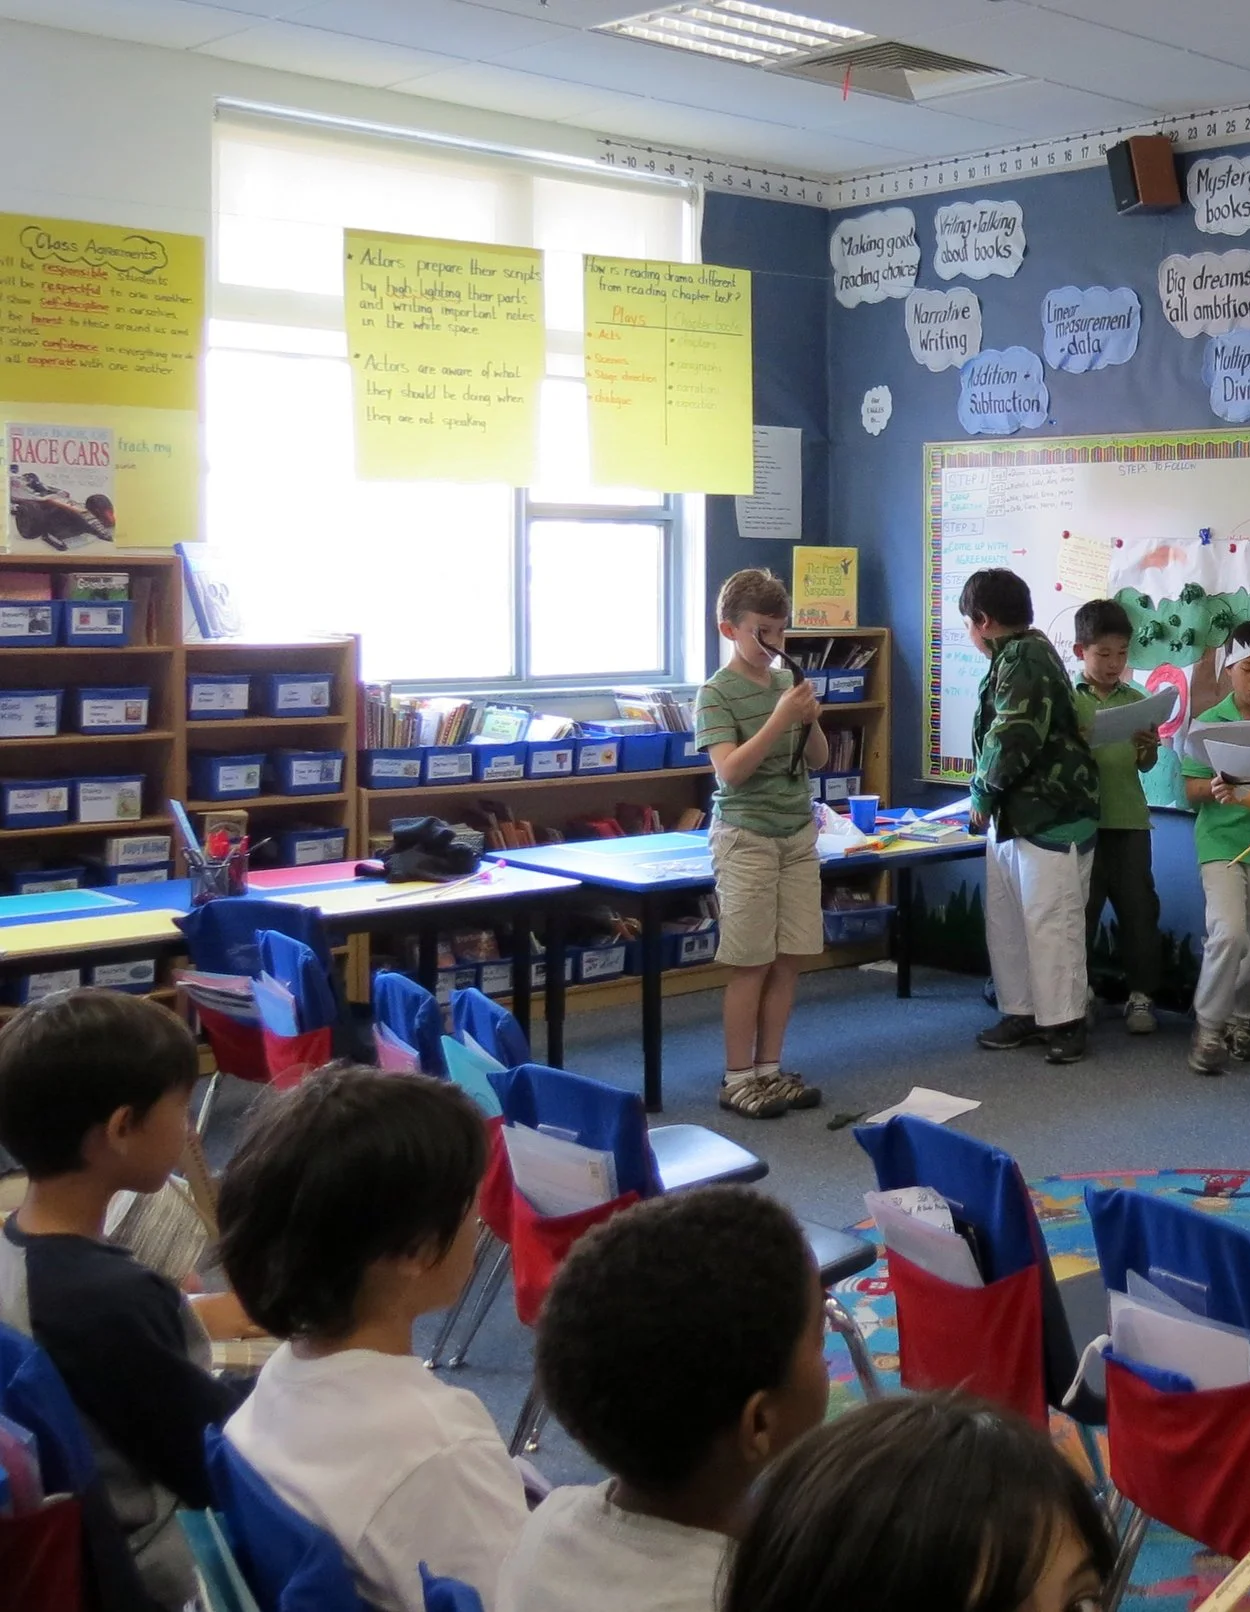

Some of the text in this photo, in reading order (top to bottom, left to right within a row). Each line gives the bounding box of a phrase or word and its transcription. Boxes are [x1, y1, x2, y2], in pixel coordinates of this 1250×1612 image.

[968, 156, 1038, 178] 10 14
[704, 171, 822, 202] -6 -2 0
[978, 211, 1017, 237] Talking
[35, 233, 78, 251] Class
[841, 229, 916, 258] Making good
[942, 236, 1012, 264] about books
[42, 263, 108, 280] responsible
[360, 248, 542, 286] Actors prepare their scripts
[584, 256, 605, 272] How
[624, 263, 661, 286] reading
[664, 265, 693, 284] drama
[698, 269, 736, 288] different
[839, 261, 918, 291] reading choices
[41, 281, 101, 297] respectful
[360, 274, 377, 298] by
[468, 283, 493, 302] their
[497, 288, 527, 307] parts
[599, 275, 622, 292] from
[626, 283, 667, 301] reading
[1167, 268, 1186, 298] Big
[359, 297, 536, 322] and writing important notes
[612, 305, 646, 327] Plays
[913, 304, 971, 325] Narrative
[1047, 301, 1078, 324] Linear
[1055, 306, 1132, 338] measurement
[362, 317, 375, 327] in
[387, 314, 404, 330] the
[413, 316, 441, 331] white
[600, 330, 621, 340] Acts
[919, 331, 968, 352] Writing
[364, 353, 522, 378] Actors are aware of what
[968, 364, 1017, 387] Addition
[367, 380, 524, 407] they should be doing when
[969, 389, 1041, 414] Subtraction
[367, 406, 486, 429] they are not speaking
[11, 436, 110, 467] RACE CARS
[1119, 462, 1197, 476] STEPS TO FOLLOW
[944, 522, 967, 532] STEP
